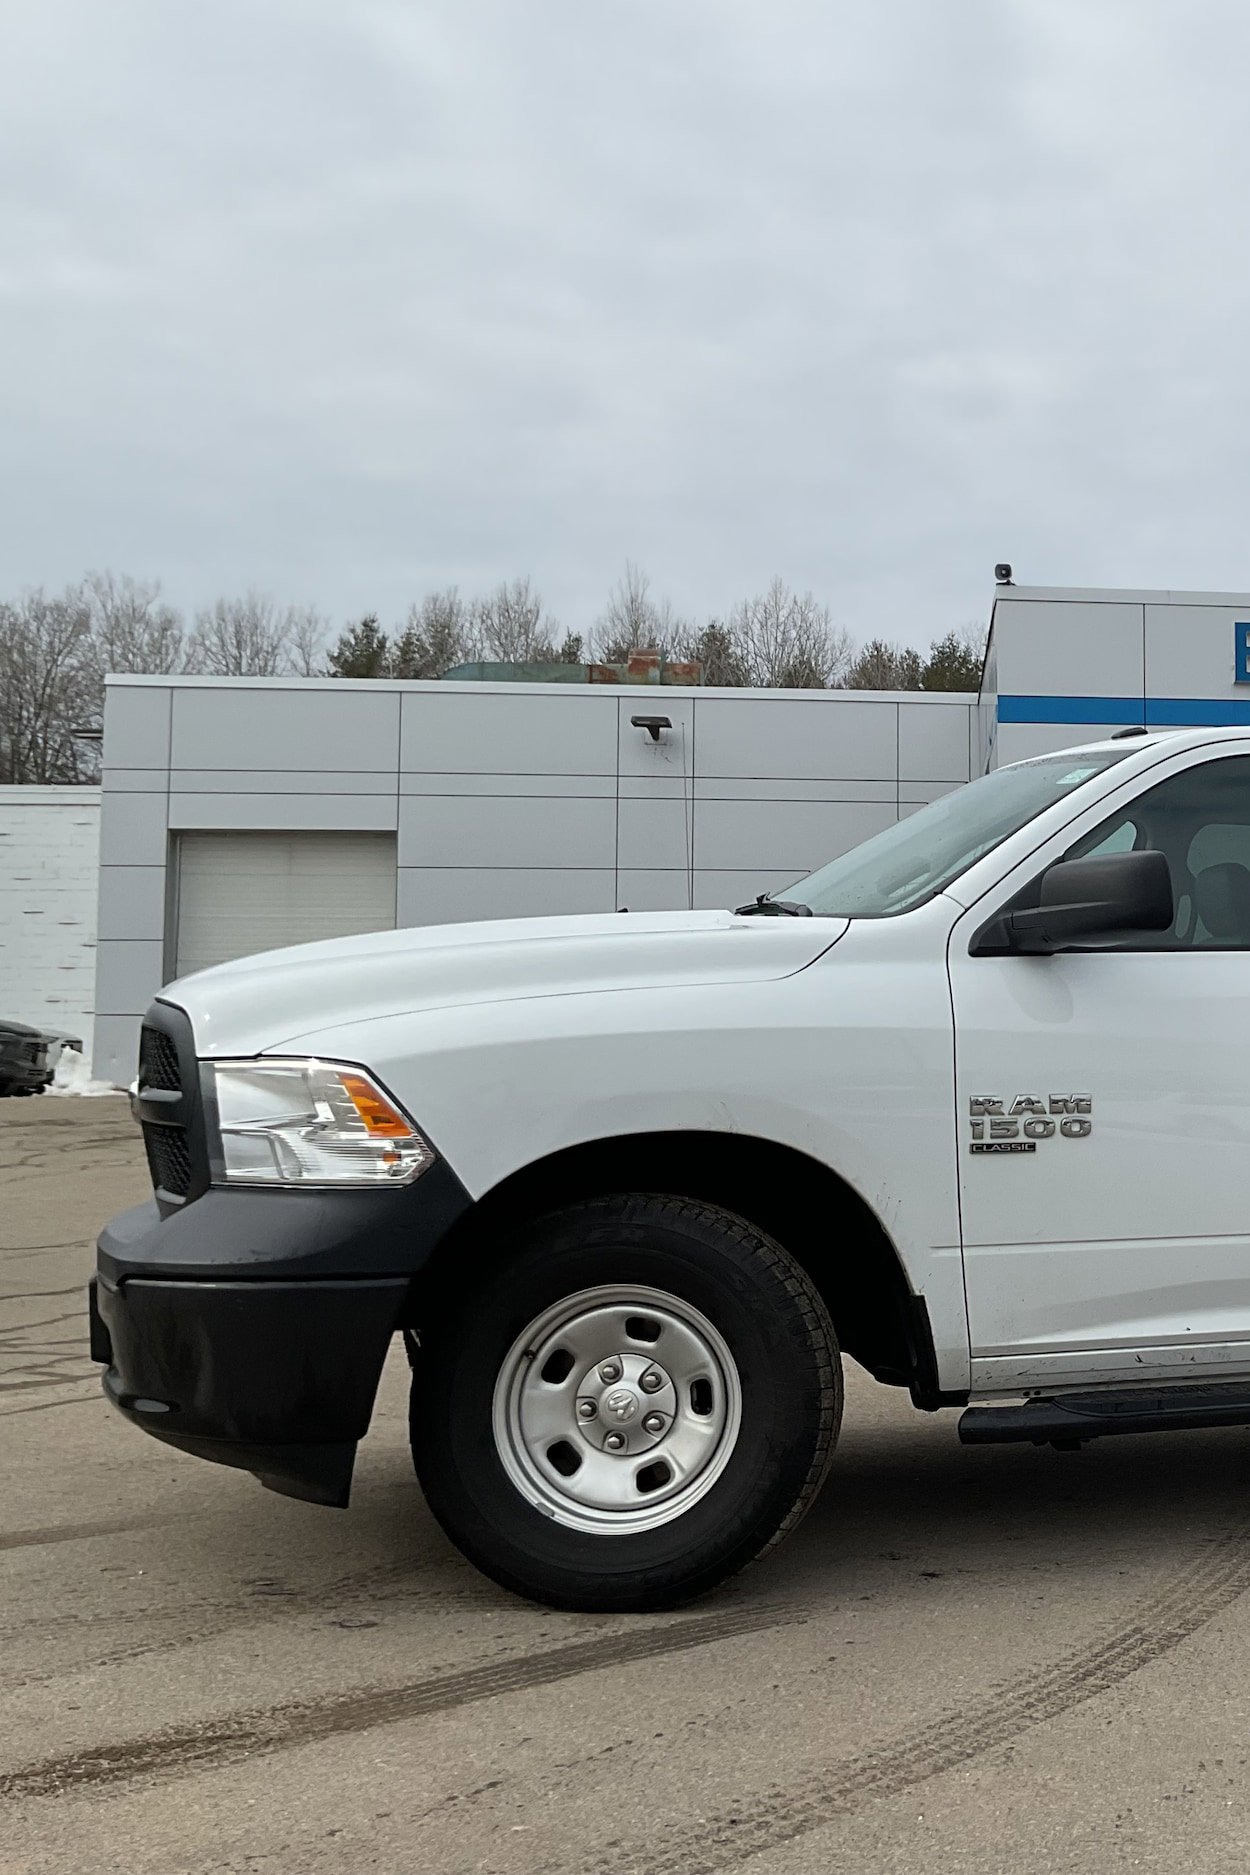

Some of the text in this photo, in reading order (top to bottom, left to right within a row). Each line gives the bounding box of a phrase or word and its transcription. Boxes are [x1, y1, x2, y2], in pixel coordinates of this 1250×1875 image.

[969, 1093, 1092, 1116] RAM
[969, 1116, 1092, 1140] 1500
[972, 1143, 1035, 1152] CLASSIC
